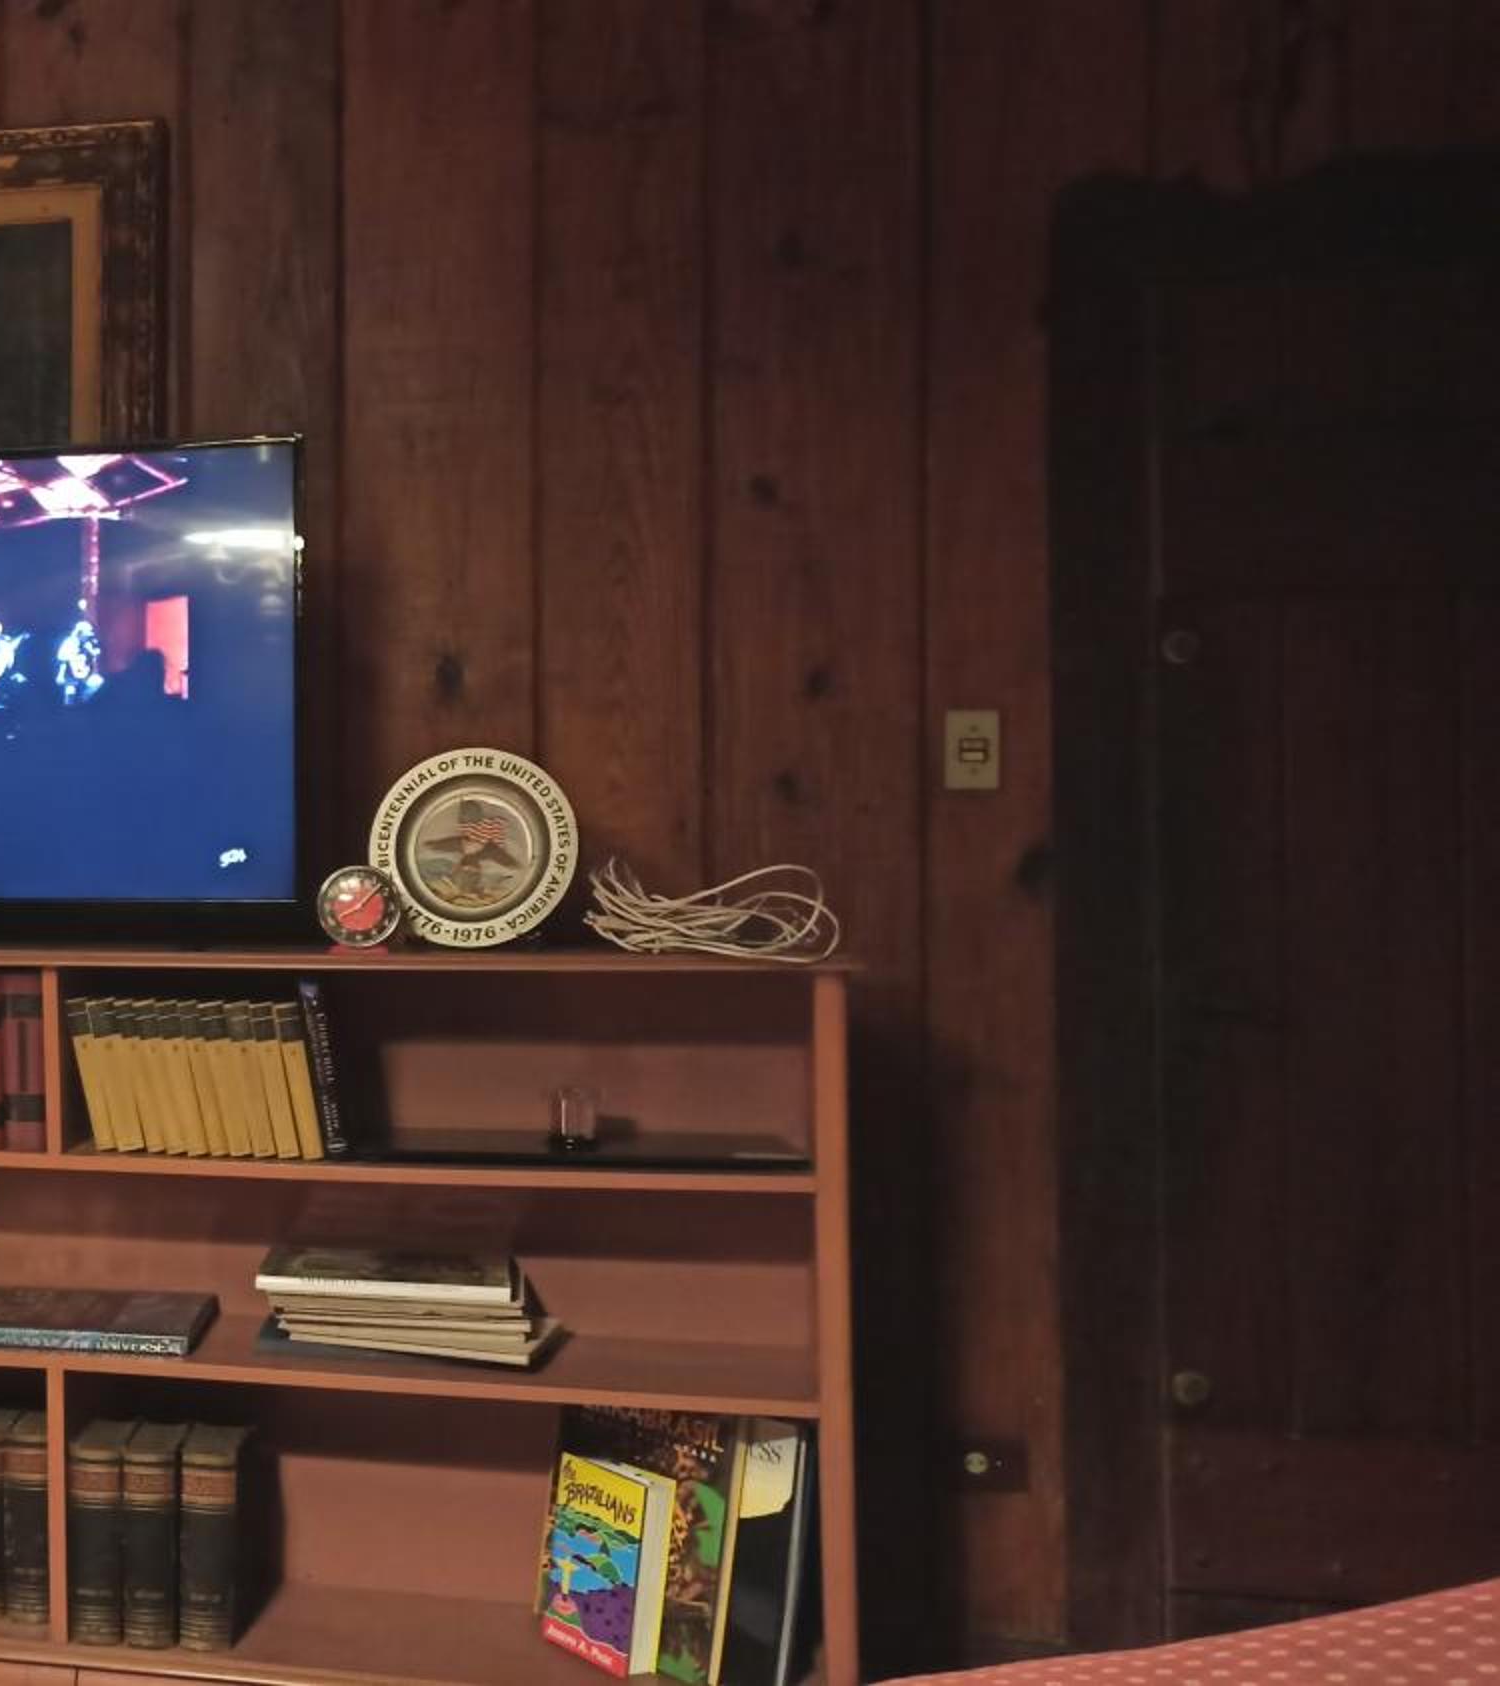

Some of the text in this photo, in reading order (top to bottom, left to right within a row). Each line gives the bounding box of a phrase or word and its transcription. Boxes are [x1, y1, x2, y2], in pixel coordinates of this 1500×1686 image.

[378, 755, 571, 930] BICENTENNIAL OF THE UNITED STATES OF AMERICA
[563, 1481, 637, 1525] BRAZILIANS
